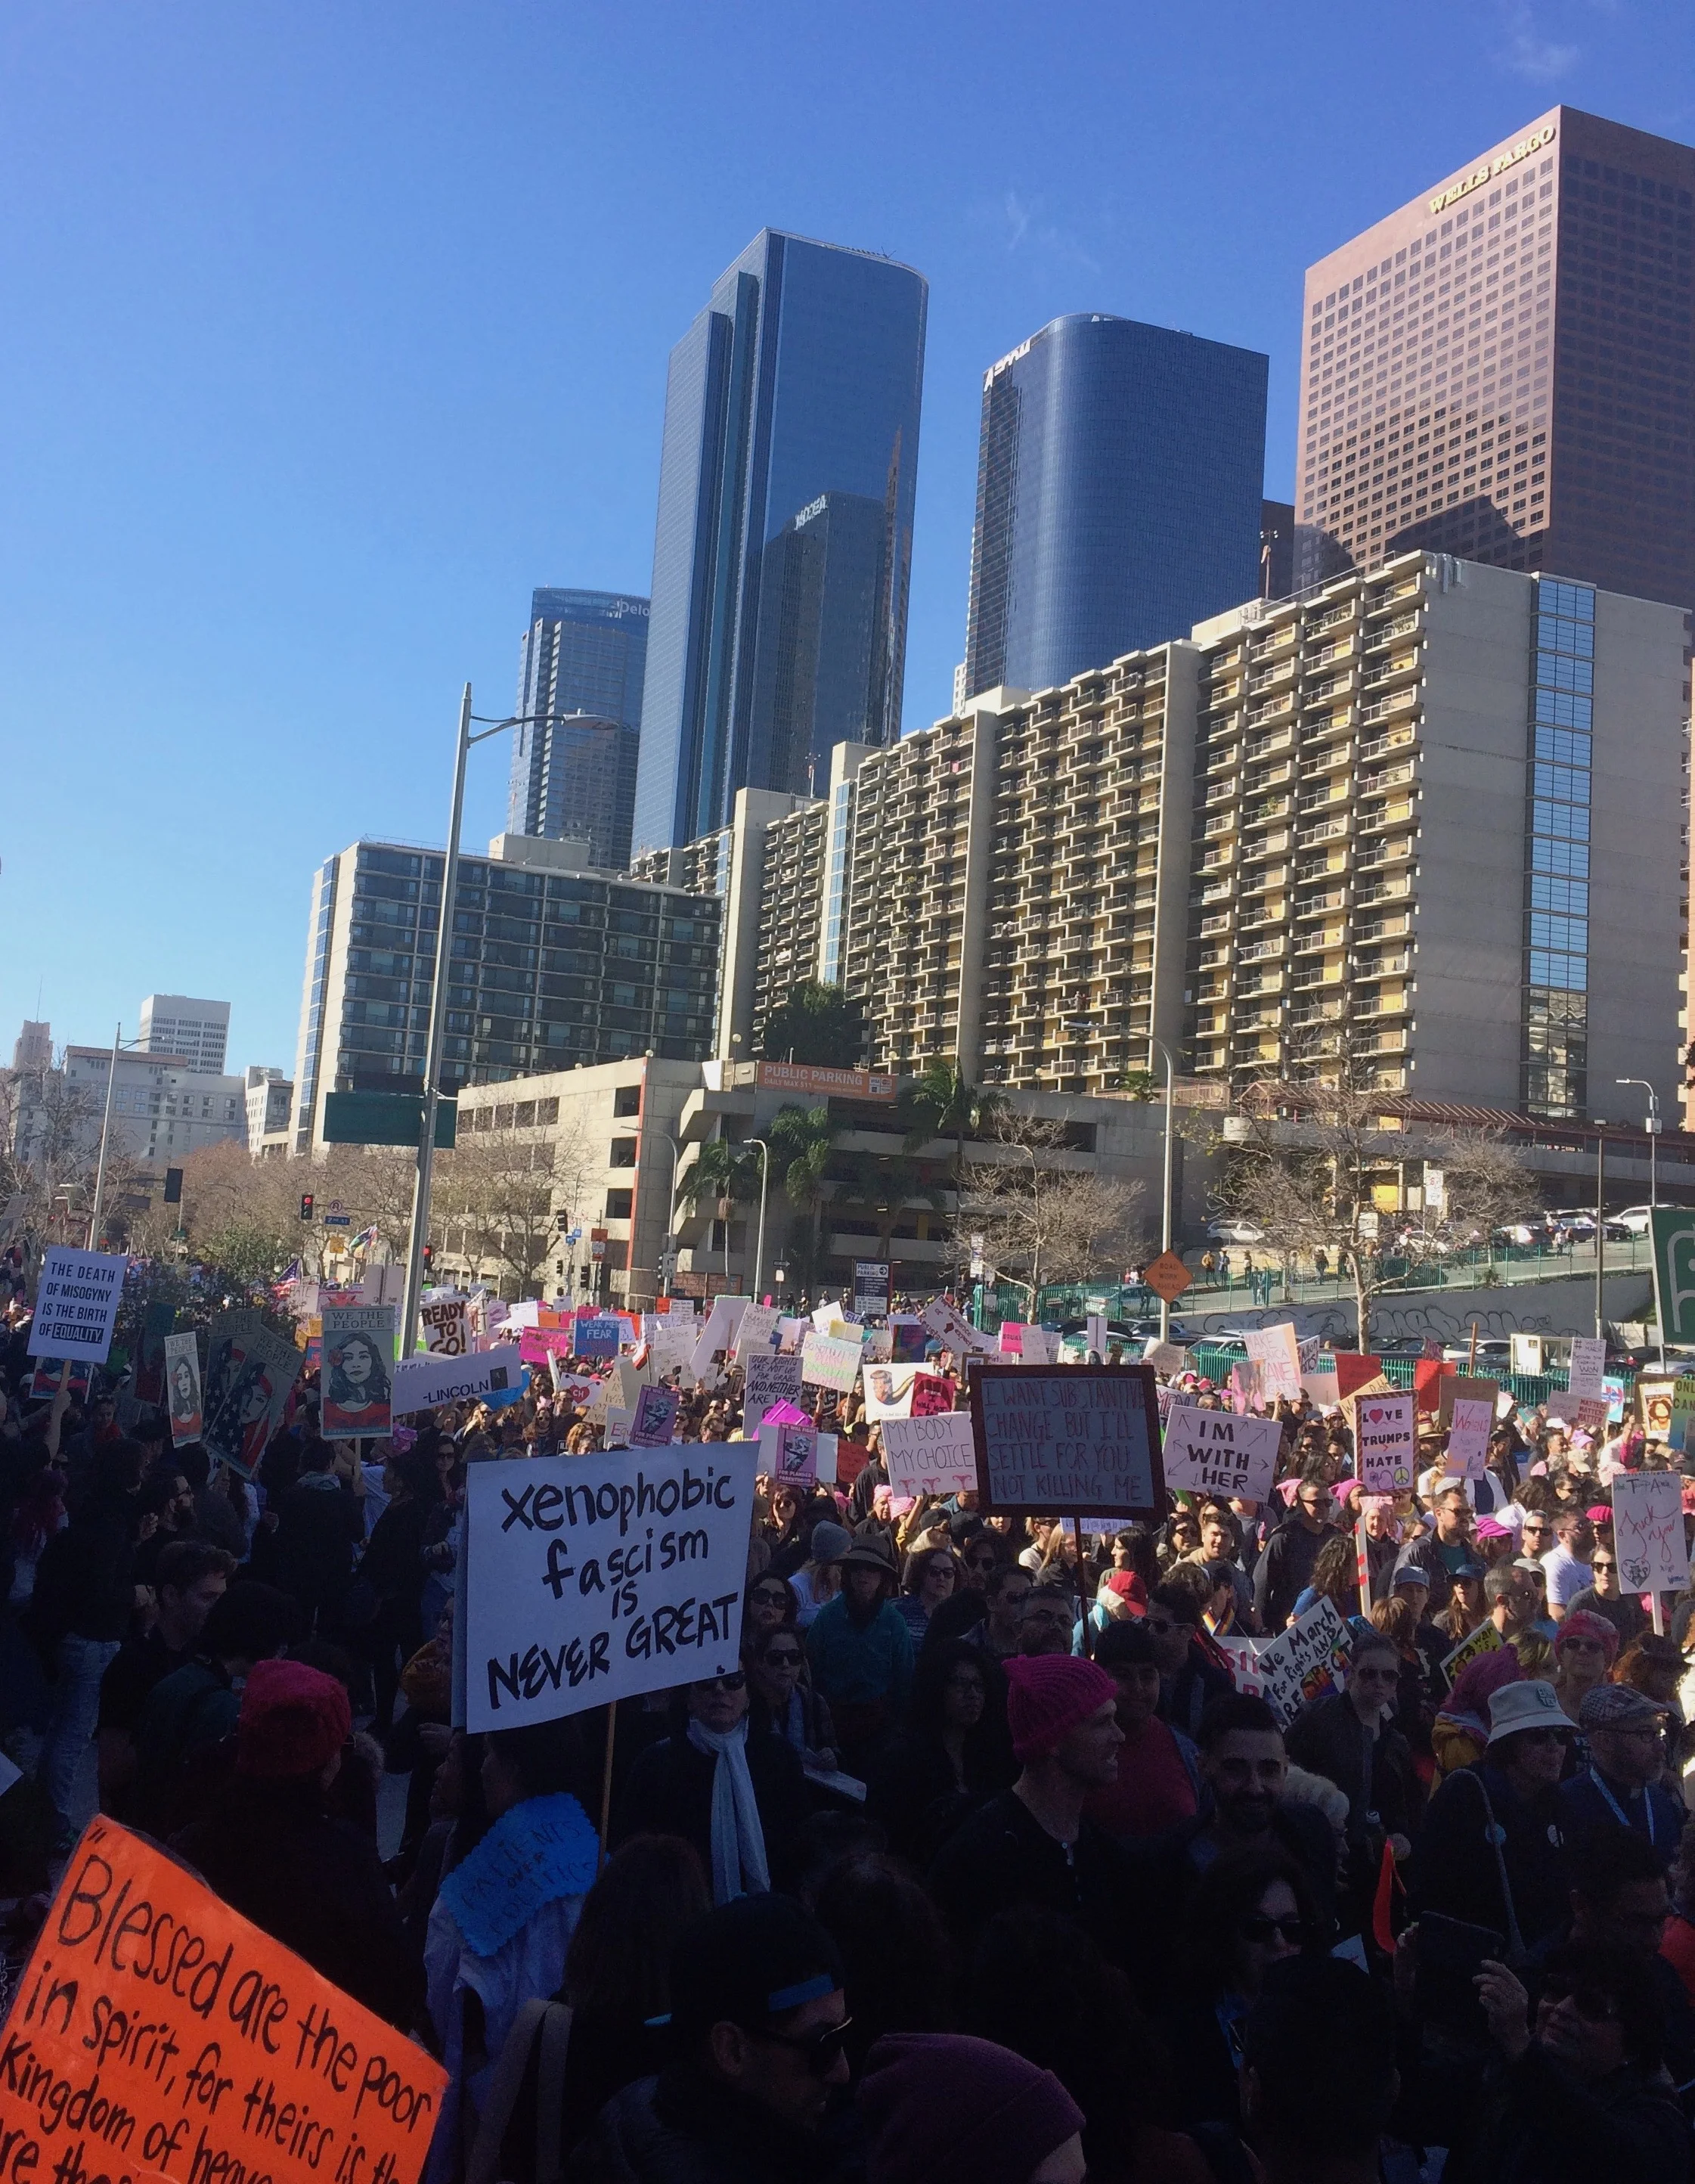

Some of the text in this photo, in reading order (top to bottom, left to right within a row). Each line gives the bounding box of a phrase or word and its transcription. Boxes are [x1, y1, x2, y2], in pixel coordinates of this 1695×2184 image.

[1429, 125, 1556, 214] WELLS FARGO
[764, 1065, 863, 1086] PUBLIC PARKING
[51, 1262, 116, 1283] THE DEATH
[46, 1282, 112, 1302] OF MISOGYNY
[42, 1302, 107, 1323] IS THE BIRTH
[332, 1311, 385, 1320] WE THE
[421, 1300, 466, 1326] READY
[39, 1323, 53, 1336] OF
[217, 1323, 253, 1334] PEOPLE
[333, 1319, 386, 1329] PEOPLE
[433, 1321, 457, 1339] TO
[581, 1320, 603, 1329] WEAK
[586, 1329, 612, 1340] FEAR
[170, 1345, 194, 1354] PEOPLE
[429, 1323, 467, 1356] GO!
[1246, 1332, 1278, 1350] MAKE
[750, 1363, 796, 1374] ARE NOT UP
[751, 1354, 799, 1366] OUR RIGHTS
[1579, 1365, 1599, 1373] WON
[756, 1372, 797, 1383] FOR GRABS
[572, 1389, 584, 1398] CH
[746, 1380, 801, 1397] AND NEITHER
[748, 1393, 770, 1404] ARE
[984, 1382, 997, 1406] I
[1002, 1380, 1048, 1407] WANT
[886, 1416, 953, 1444] MY BODY
[986, 1410, 1054, 1442] CHANGE
[1064, 1411, 1091, 1440] BUT
[1362, 1432, 1411, 1447] TRUMPS
[891, 1447, 915, 1472] MY
[916, 1444, 975, 1470] CHOICE
[989, 1442, 1131, 1472] SETTLE FOR YOU
[1187, 1444, 1250, 1471] WITH
[1366, 1455, 1402, 1468] HATE
[779, 1475, 811, 1483] PARENTHOOD
[994, 1474, 1142, 1502] NOT KILLING ME
[1201, 1466, 1248, 1494] HER
[500, 1466, 735, 1537] xenophobic
[541, 1527, 708, 1599] fascism
[1259, 1602, 1337, 1677] We March
[487, 1631, 610, 1710] NEVER
[1284, 1651, 1312, 1683] Rights
[228, 1969, 289, 2055] are
[297, 2003, 358, 2092] the
[352, 2055, 432, 2133] poor
[23, 1961, 366, 2184] in spirit, for theirs is
[143, 2117, 191, 2173] of
